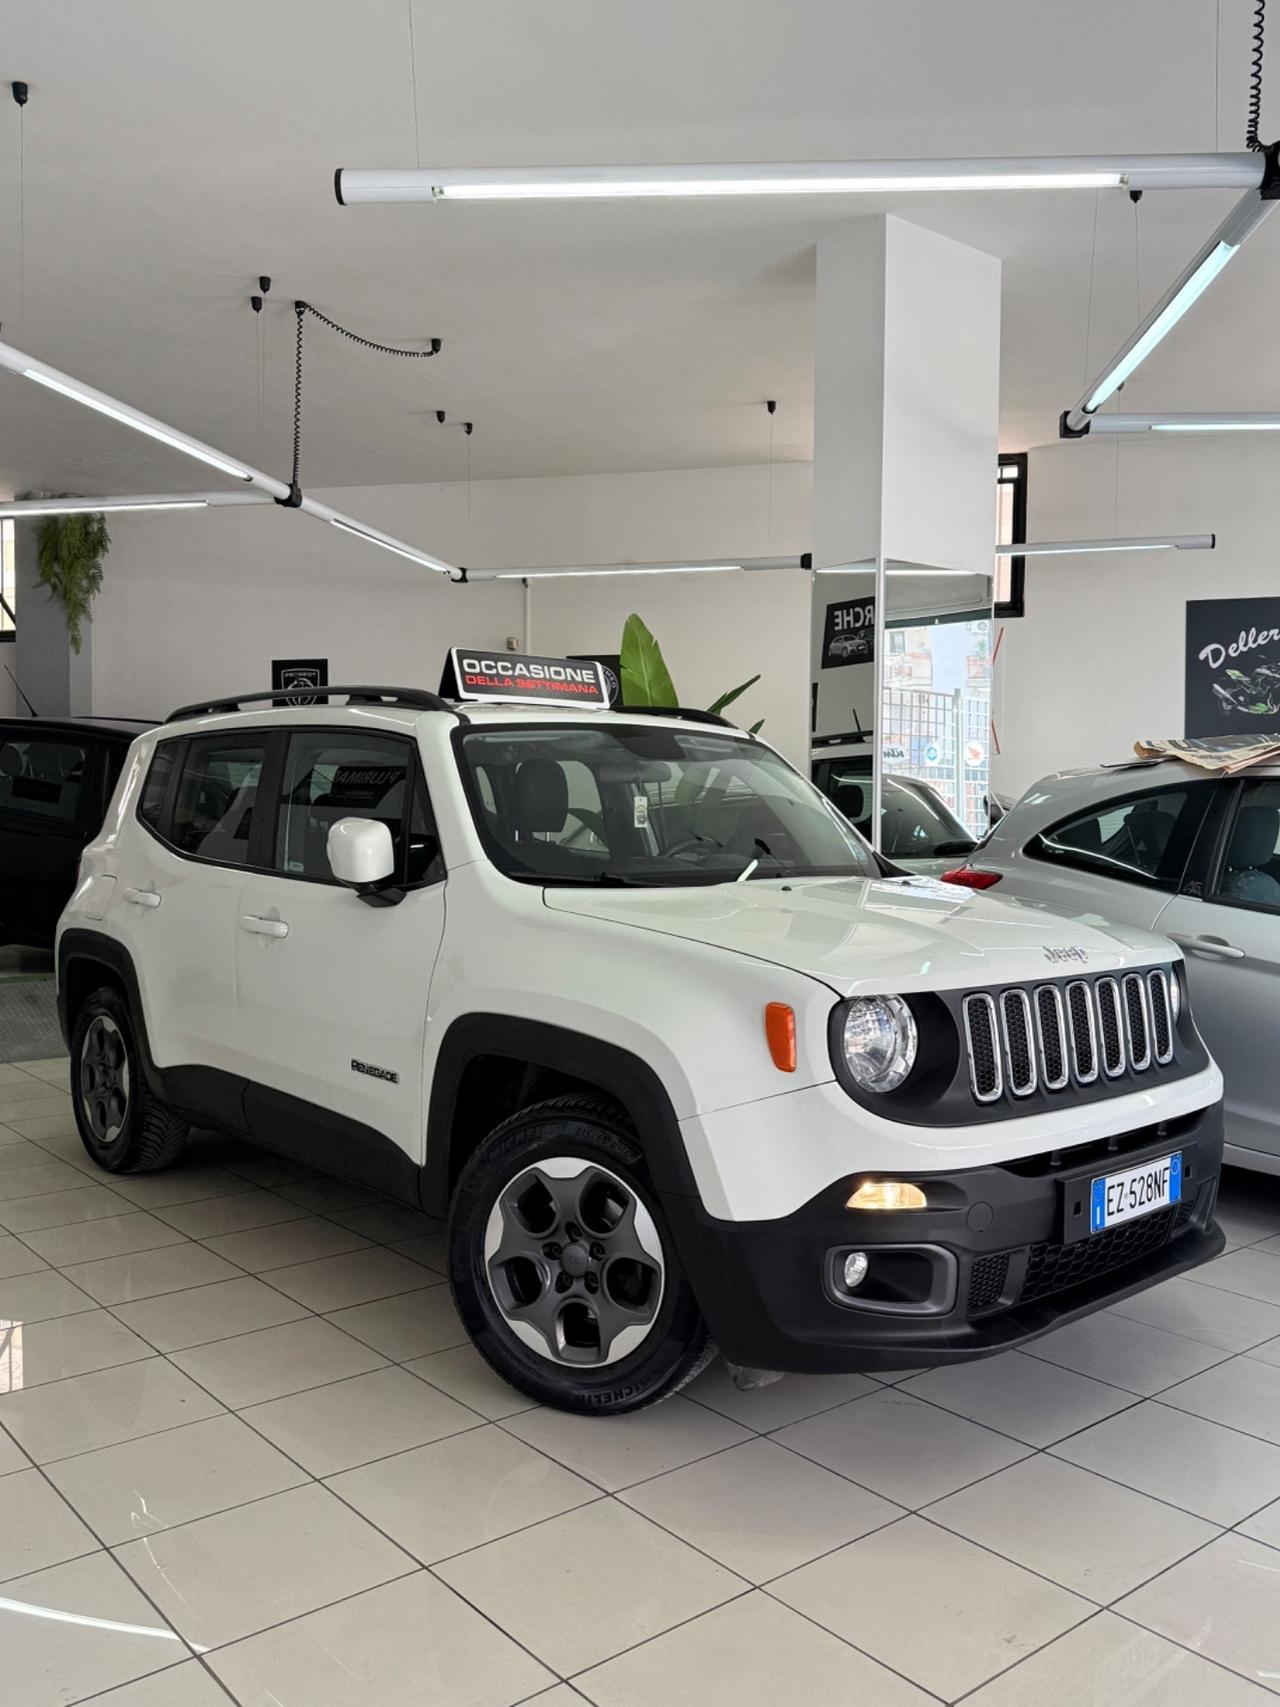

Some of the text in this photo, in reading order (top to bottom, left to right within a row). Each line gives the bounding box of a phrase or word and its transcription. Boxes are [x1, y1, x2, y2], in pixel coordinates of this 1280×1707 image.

[462, 658, 596, 684] OCCASIONE
[465, 674, 598, 695] DELLA SETTIMANA
[351, 1059, 399, 1084] RENEGADE
[1106, 1166, 1170, 1217] EZ 528NF
